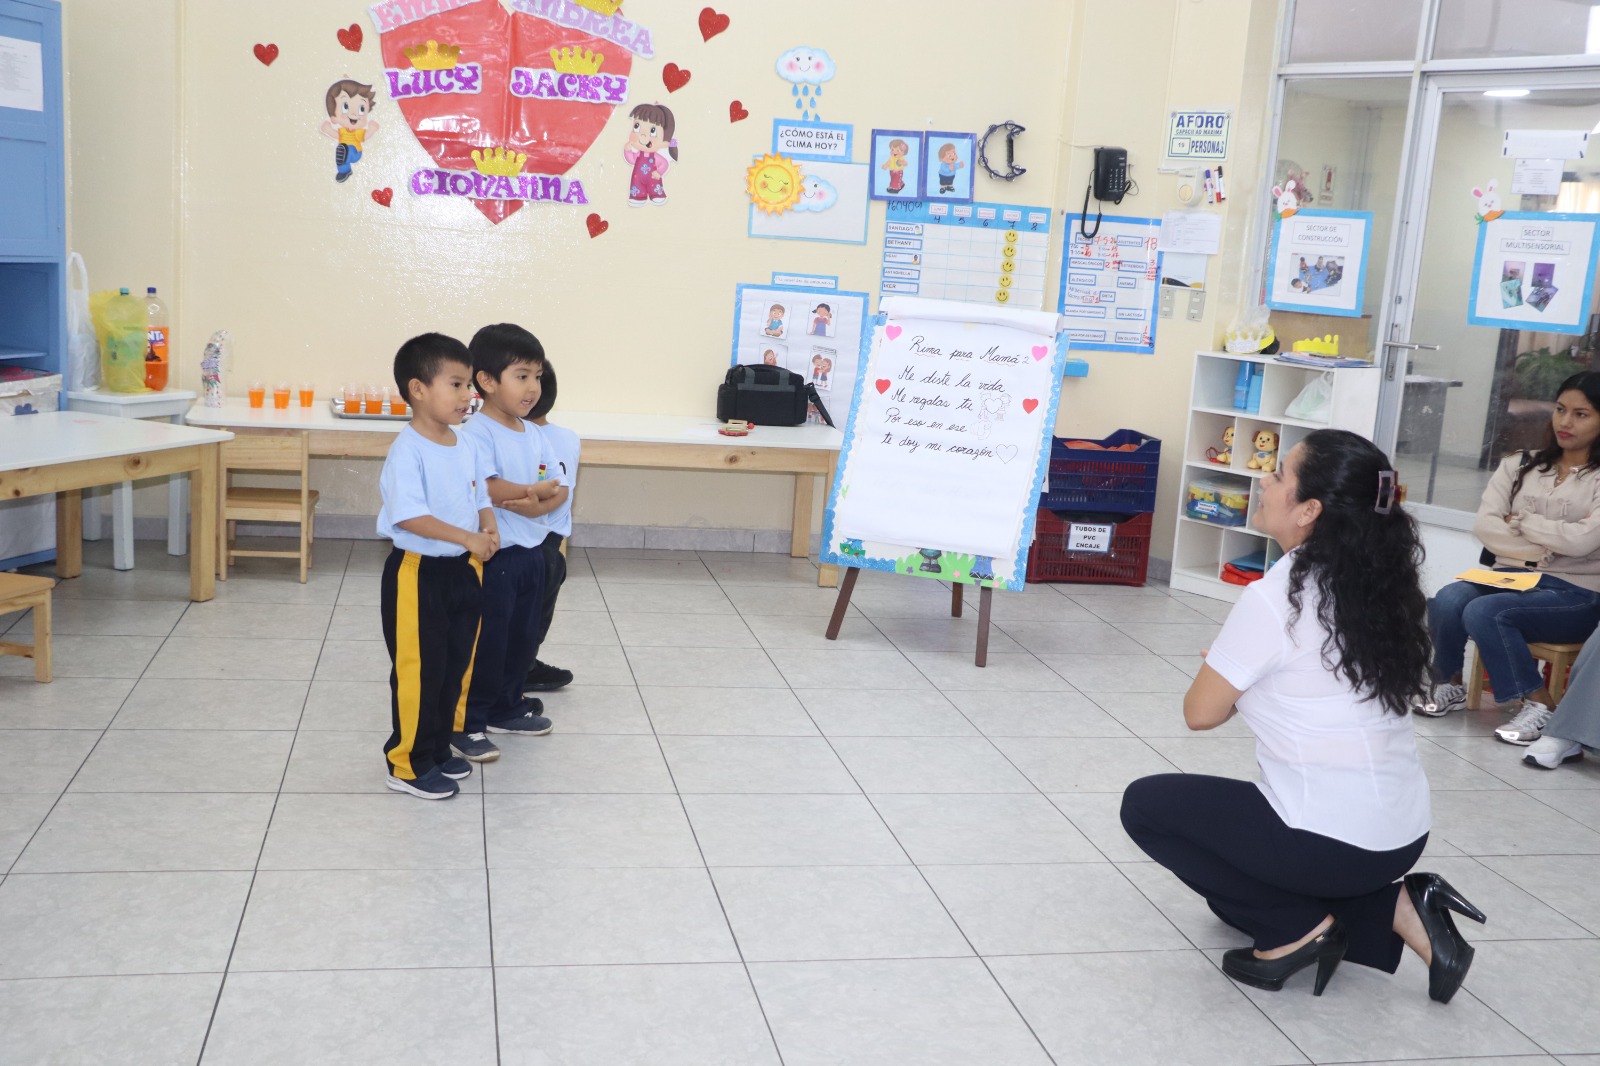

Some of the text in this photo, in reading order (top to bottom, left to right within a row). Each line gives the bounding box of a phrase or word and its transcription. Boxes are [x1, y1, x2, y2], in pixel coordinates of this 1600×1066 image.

[386, 65, 479, 98] LUCY
[511, 69, 628, 101] JACKY
[1175, 115, 1225, 129] AFORO
[780, 128, 845, 141] ¿CÓMO ESTÁ EL
[785, 139, 838, 150] CLIMA HOY?
[1191, 140, 1225, 154] PERSONAS
[411, 169, 589, 205] GIOVANNA
[933, 215, 941, 223] 4
[983, 219, 989, 227] 6
[1306, 224, 1328, 232] SECTOR
[1523, 229, 1551, 237] SECTOR
[1505, 242, 1565, 251] MULTISENSORIAL
[147, 330, 165, 341] NTA
[909, 335, 943, 356] Rima
[949, 349, 973, 360] para
[979, 345, 1020, 364] Mamá
[898, 365, 1006, 393] Me diste la vida
[891, 387, 973, 411] Me regalas tu
[884, 407, 968, 433] Por eso en ese
[881, 431, 994, 461] te doy mi corazón
